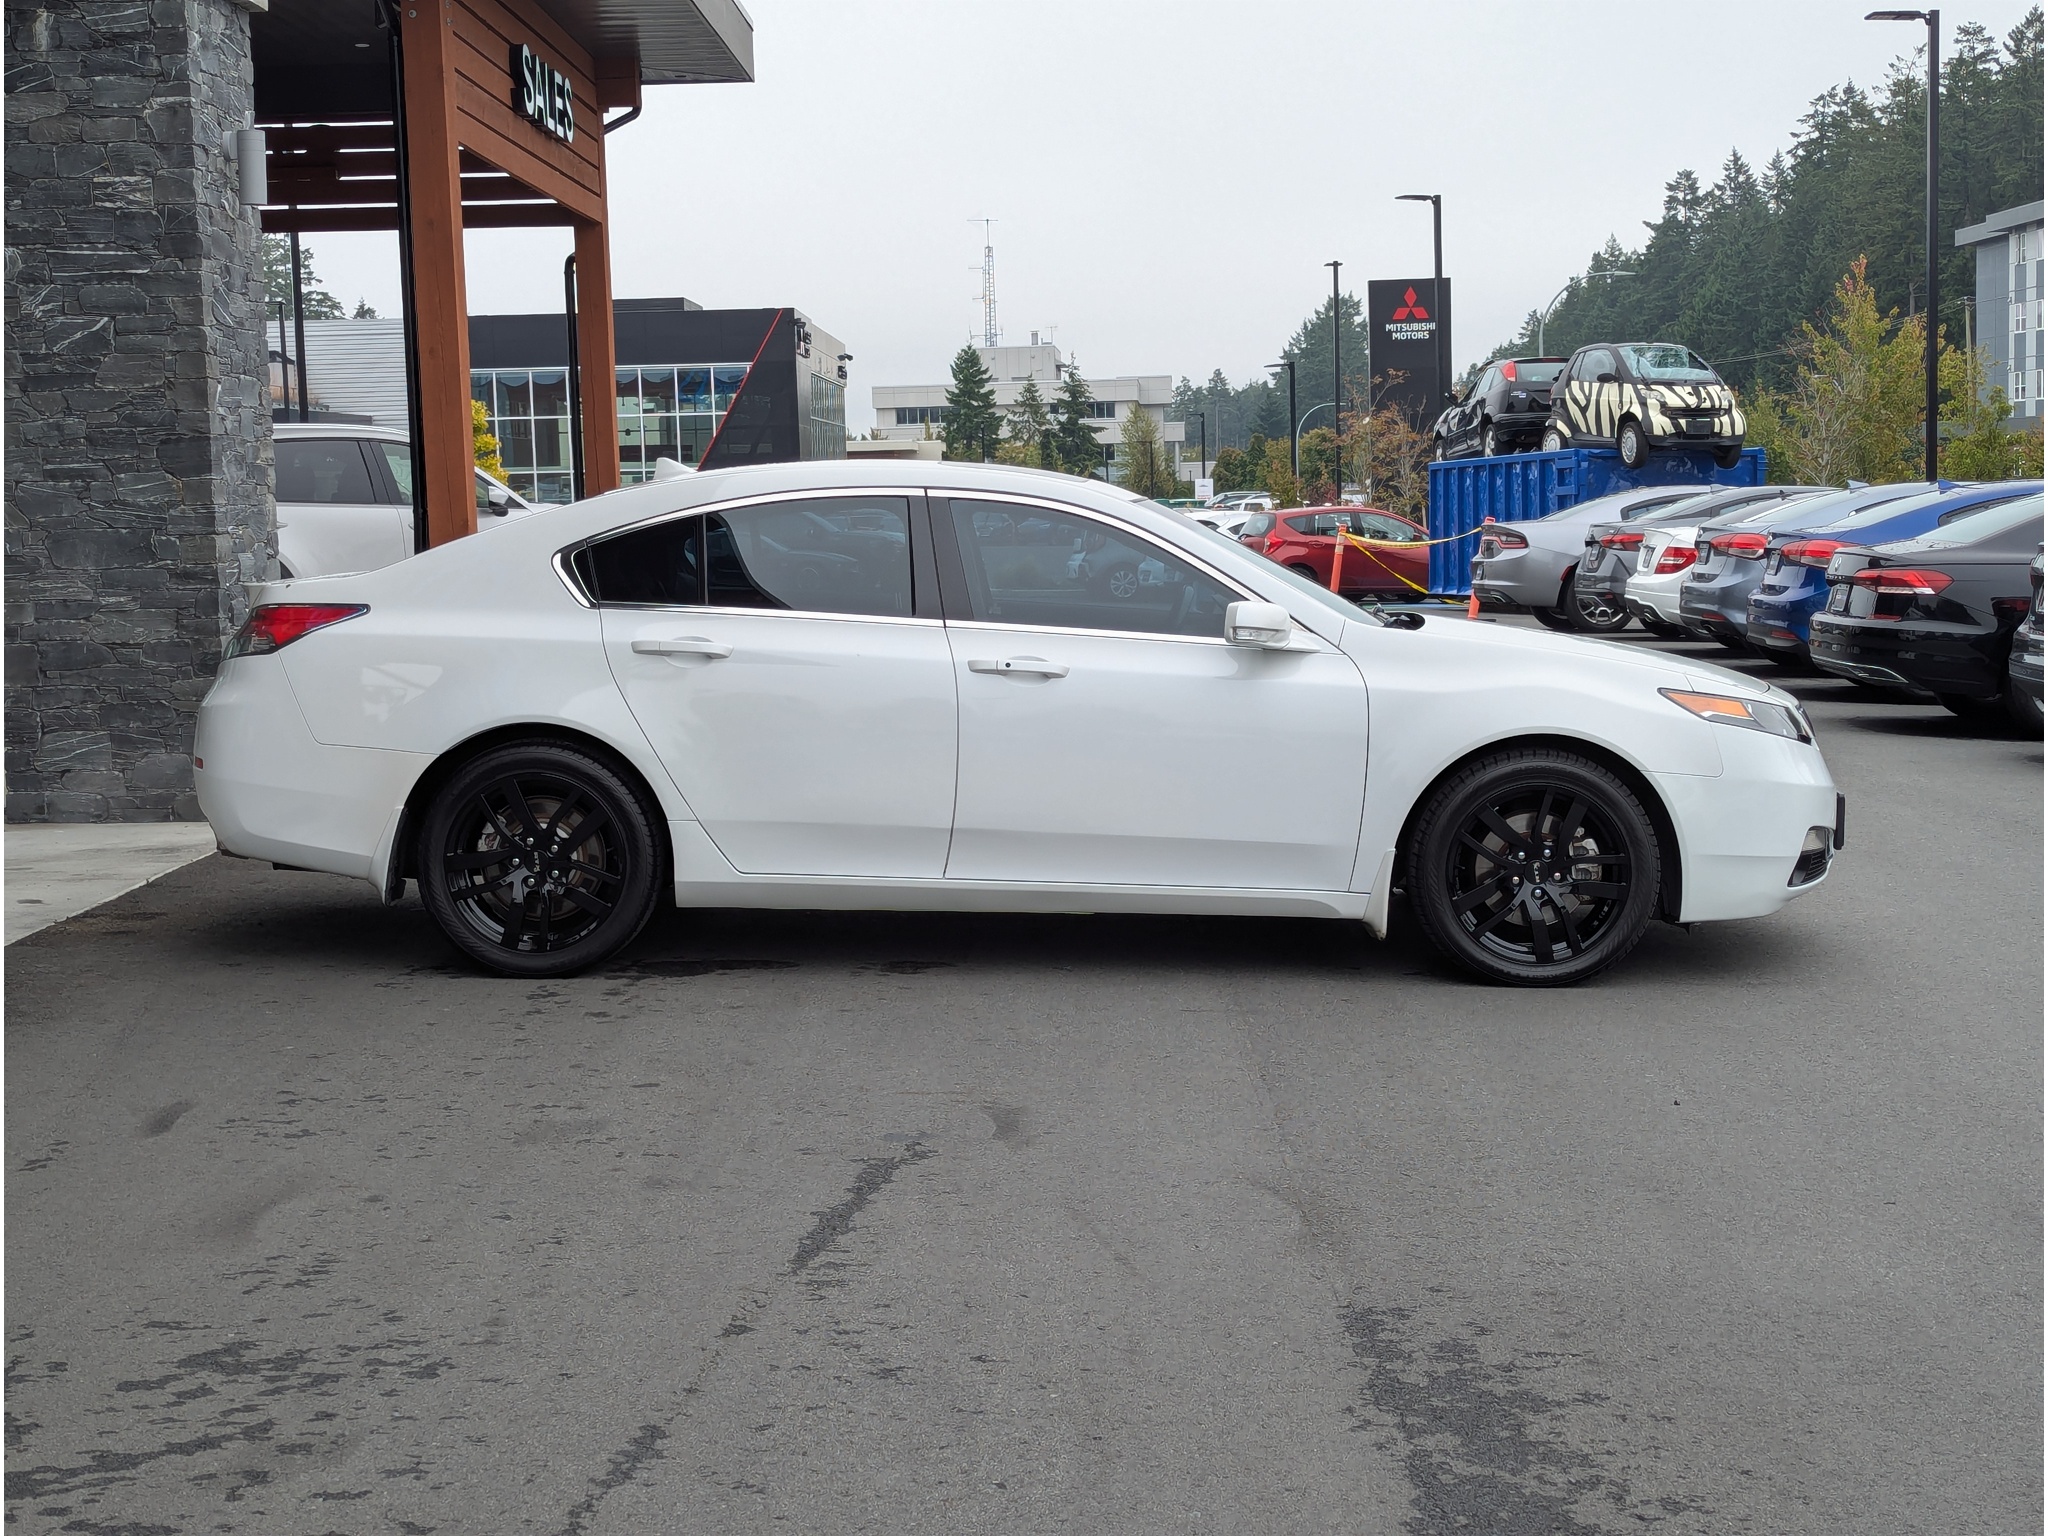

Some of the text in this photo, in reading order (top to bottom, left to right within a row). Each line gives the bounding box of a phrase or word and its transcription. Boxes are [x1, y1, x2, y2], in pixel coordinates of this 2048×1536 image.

[522, 44, 574, 143] SALES
[1386, 322, 1436, 332] MITSUBISHI
[1392, 331, 1429, 340] MOTORS
